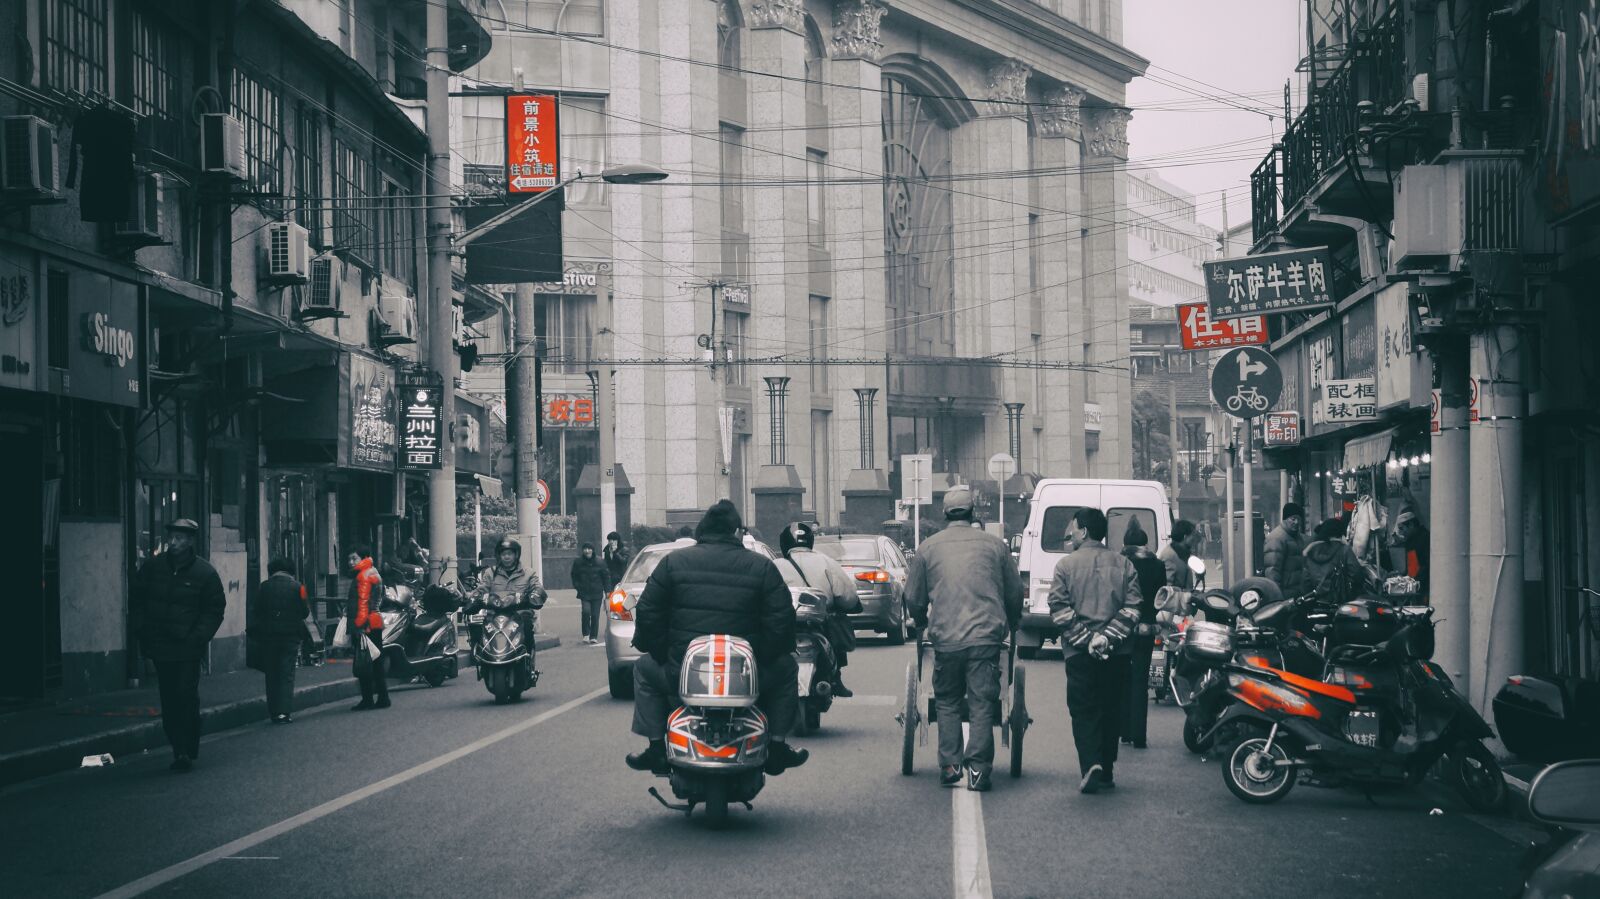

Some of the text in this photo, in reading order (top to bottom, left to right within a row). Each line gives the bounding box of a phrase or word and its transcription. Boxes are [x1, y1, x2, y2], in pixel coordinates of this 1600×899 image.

[523, 101, 540, 162] 前景小筑
[510, 163, 554, 175] 住宿请进
[1228, 258, 1326, 303] 尔萨牛羊肉
[94, 312, 133, 367] Singo
[1327, 383, 1376, 398] 配框
[1327, 402, 1377, 418] 裱画
[405, 404, 436, 464] 兰州拉面
[1331, 477, 1357, 495] 专业
